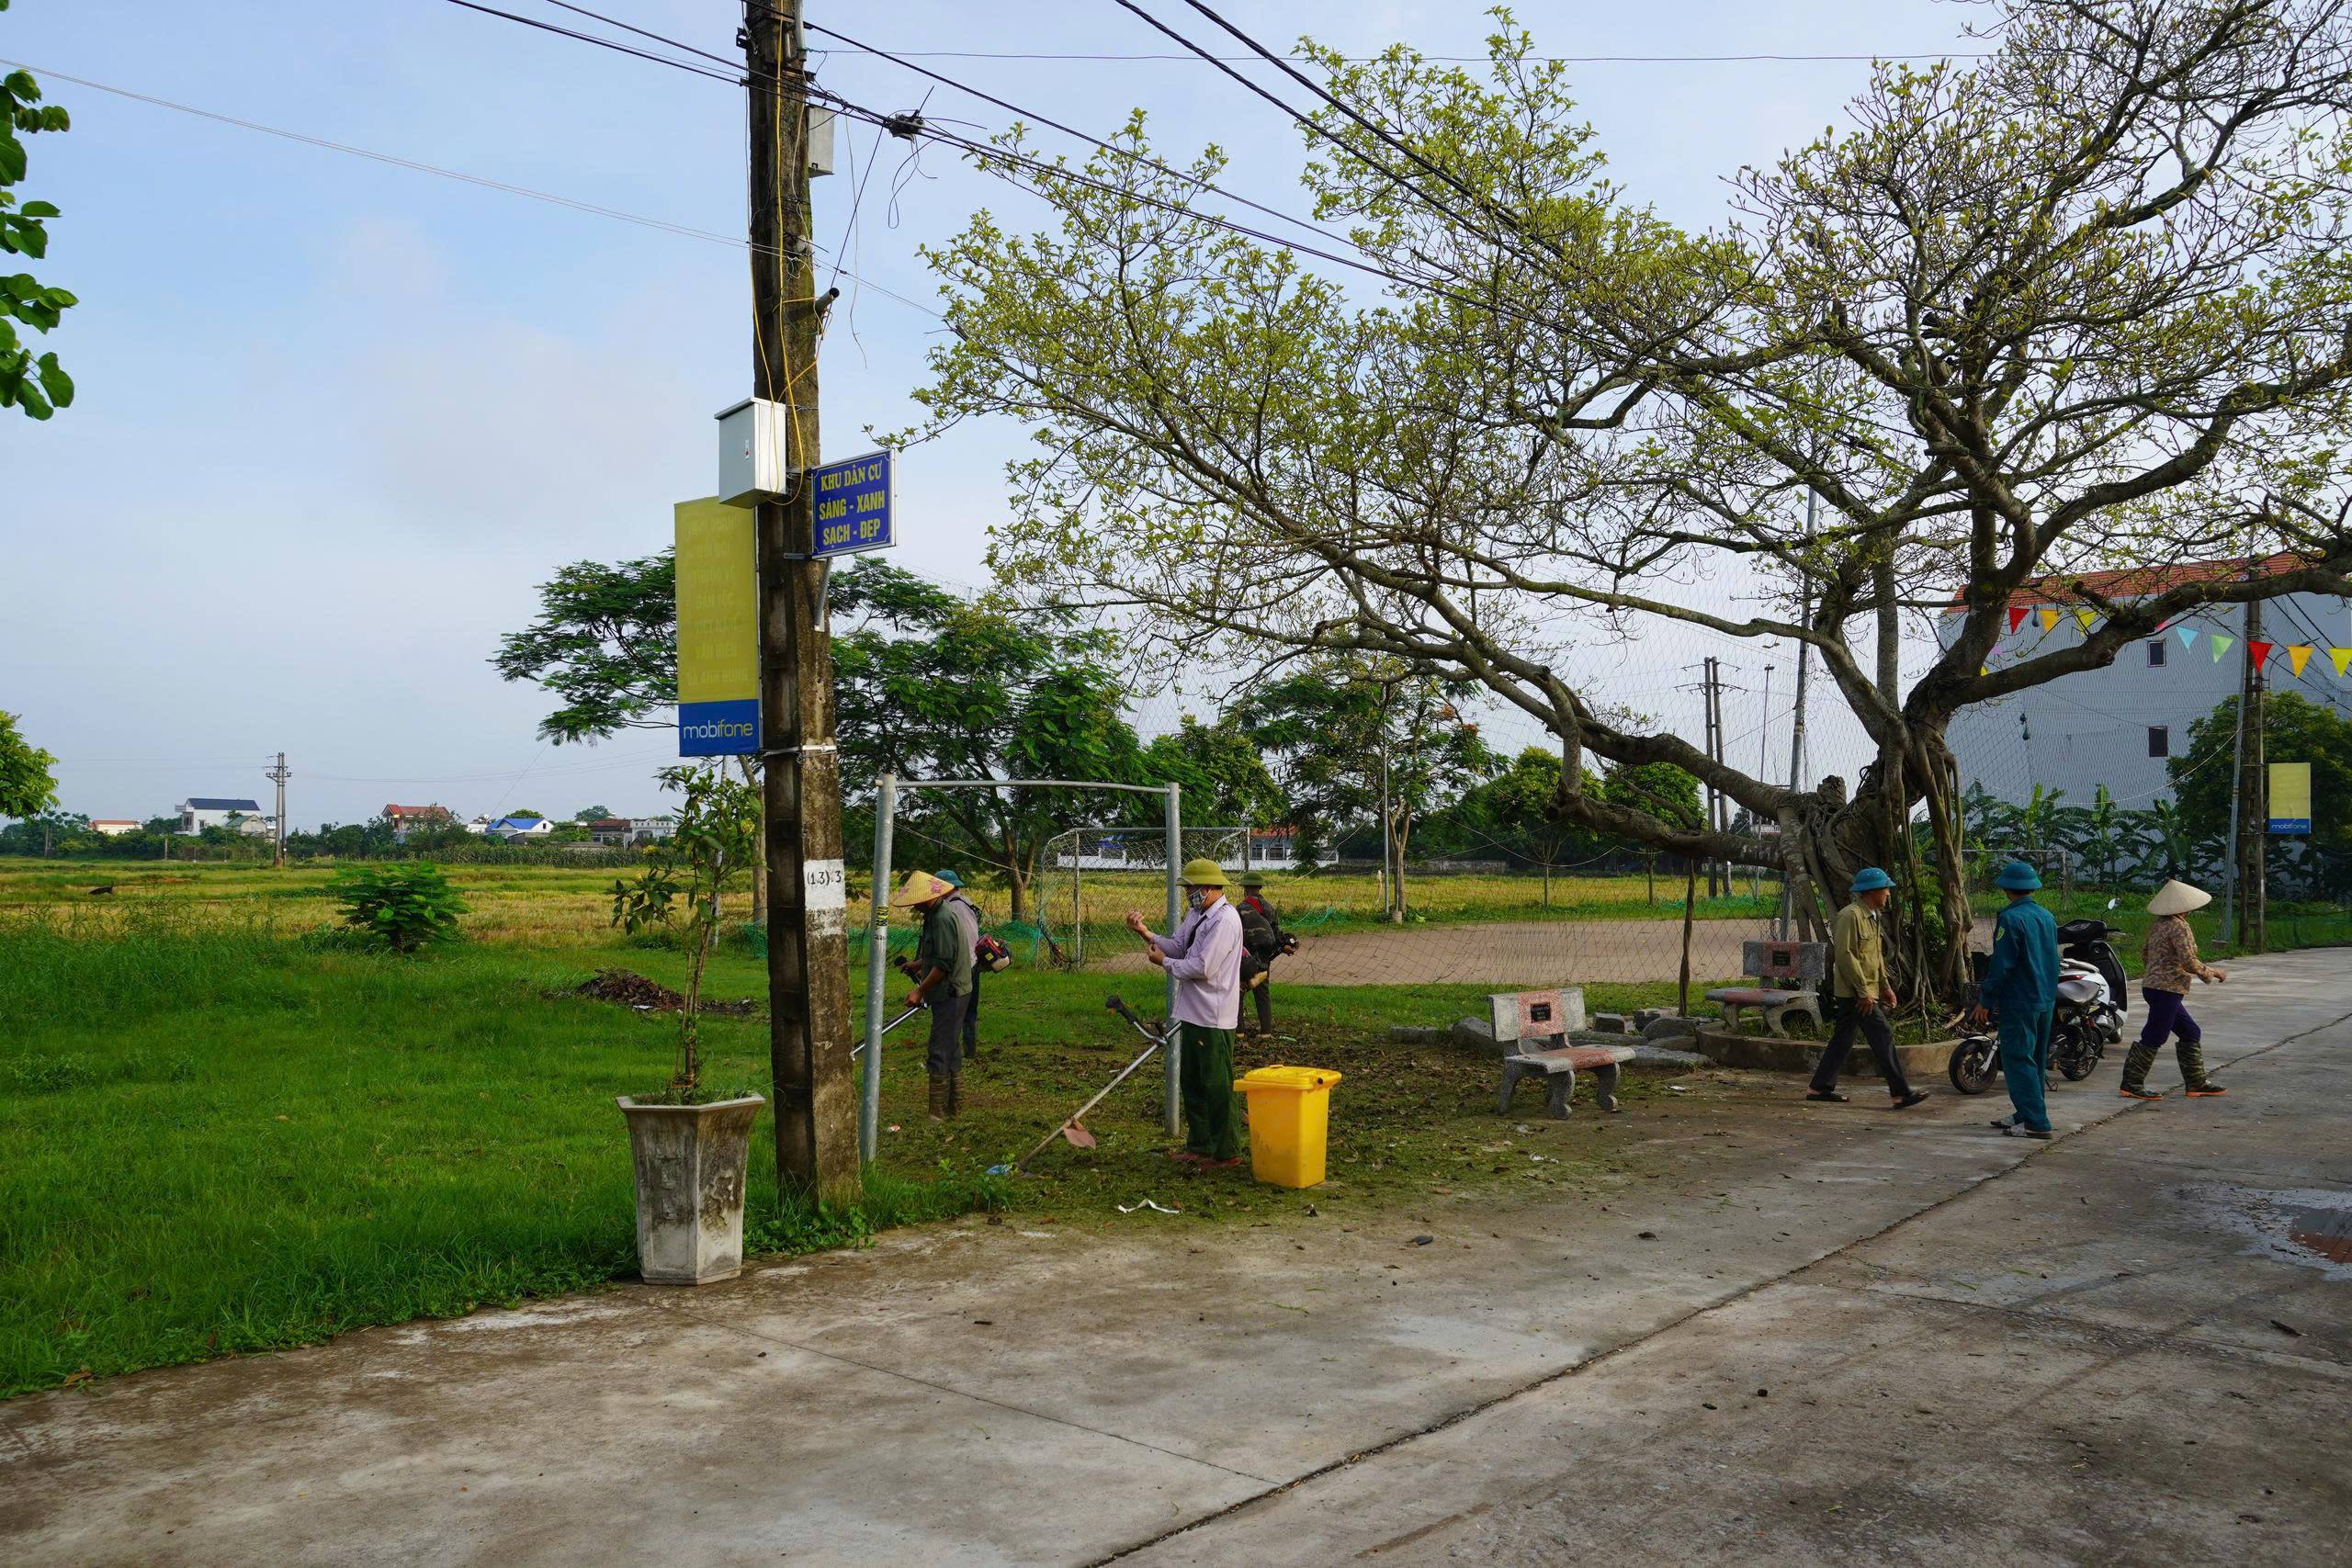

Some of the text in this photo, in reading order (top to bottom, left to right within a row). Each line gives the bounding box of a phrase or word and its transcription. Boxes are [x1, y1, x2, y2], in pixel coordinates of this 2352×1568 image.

[820, 459, 883, 491] KHU DÂN CƯ
[820, 498, 846, 521] SÁNG
[856, 491, 885, 513] XANH
[823, 524, 851, 548] SẠCH
[860, 518, 881, 542] ĐẸP
[683, 719, 753, 739] mobifone
